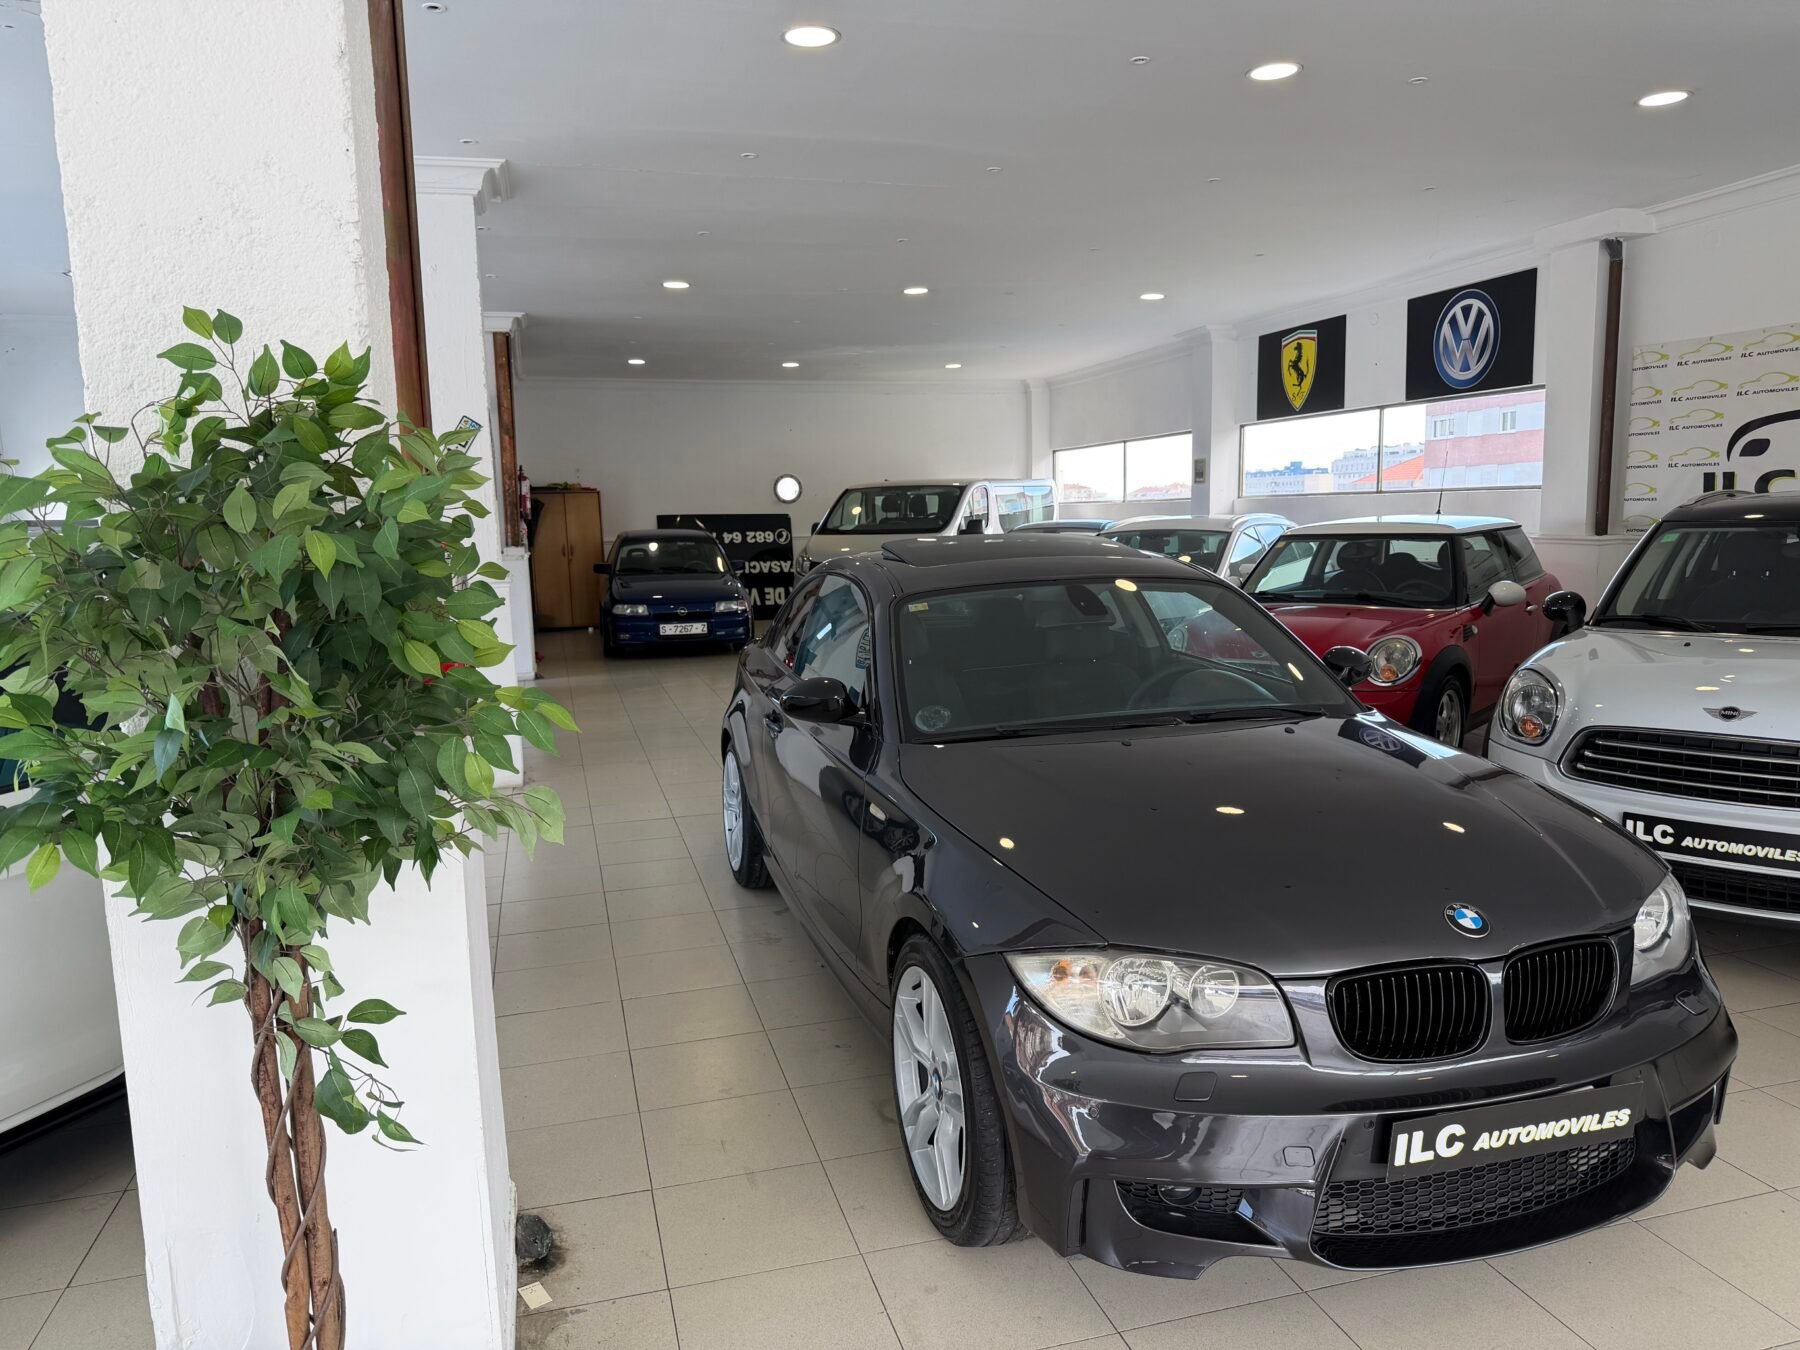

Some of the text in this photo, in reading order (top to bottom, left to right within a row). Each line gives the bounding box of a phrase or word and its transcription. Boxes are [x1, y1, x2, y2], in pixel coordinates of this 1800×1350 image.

[1756, 347, 1800, 356] AUTOMOVILE
[1692, 356, 1732, 364] AUTOMOVILES
[1752, 386, 1799, 395] AUTOMOVILES
[722, 532, 742, 544] 64
[746, 532, 774, 543] 682
[765, 588, 785, 606] DE
[1394, 1108, 1632, 1167] ILC AUTOMOVILES
